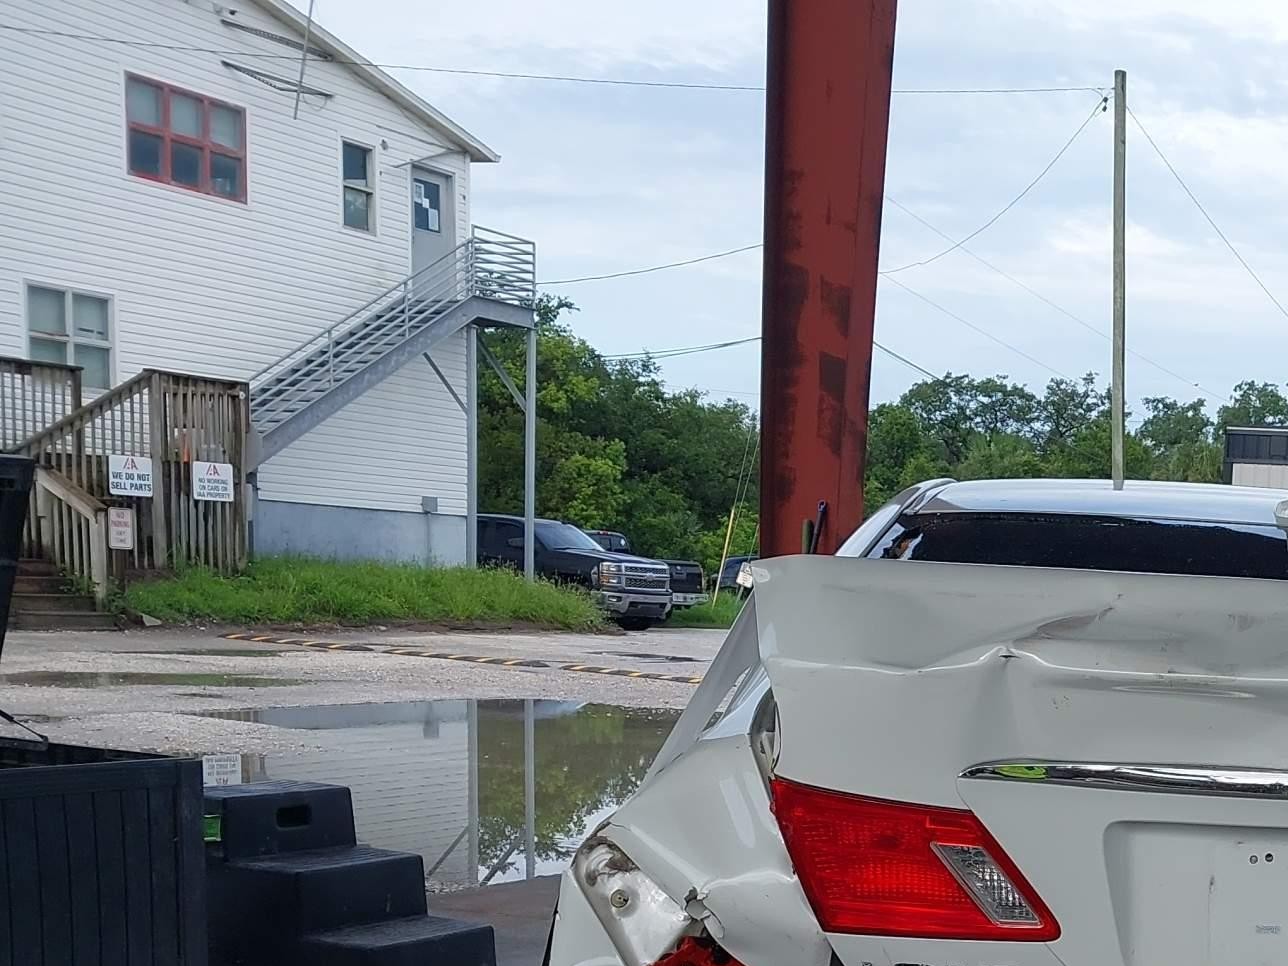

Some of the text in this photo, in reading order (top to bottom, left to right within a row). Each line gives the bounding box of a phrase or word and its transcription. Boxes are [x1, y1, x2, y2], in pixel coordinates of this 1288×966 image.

[112, 471, 150, 482] WE DO NOT
[111, 480, 152, 492] SELL PARTS
